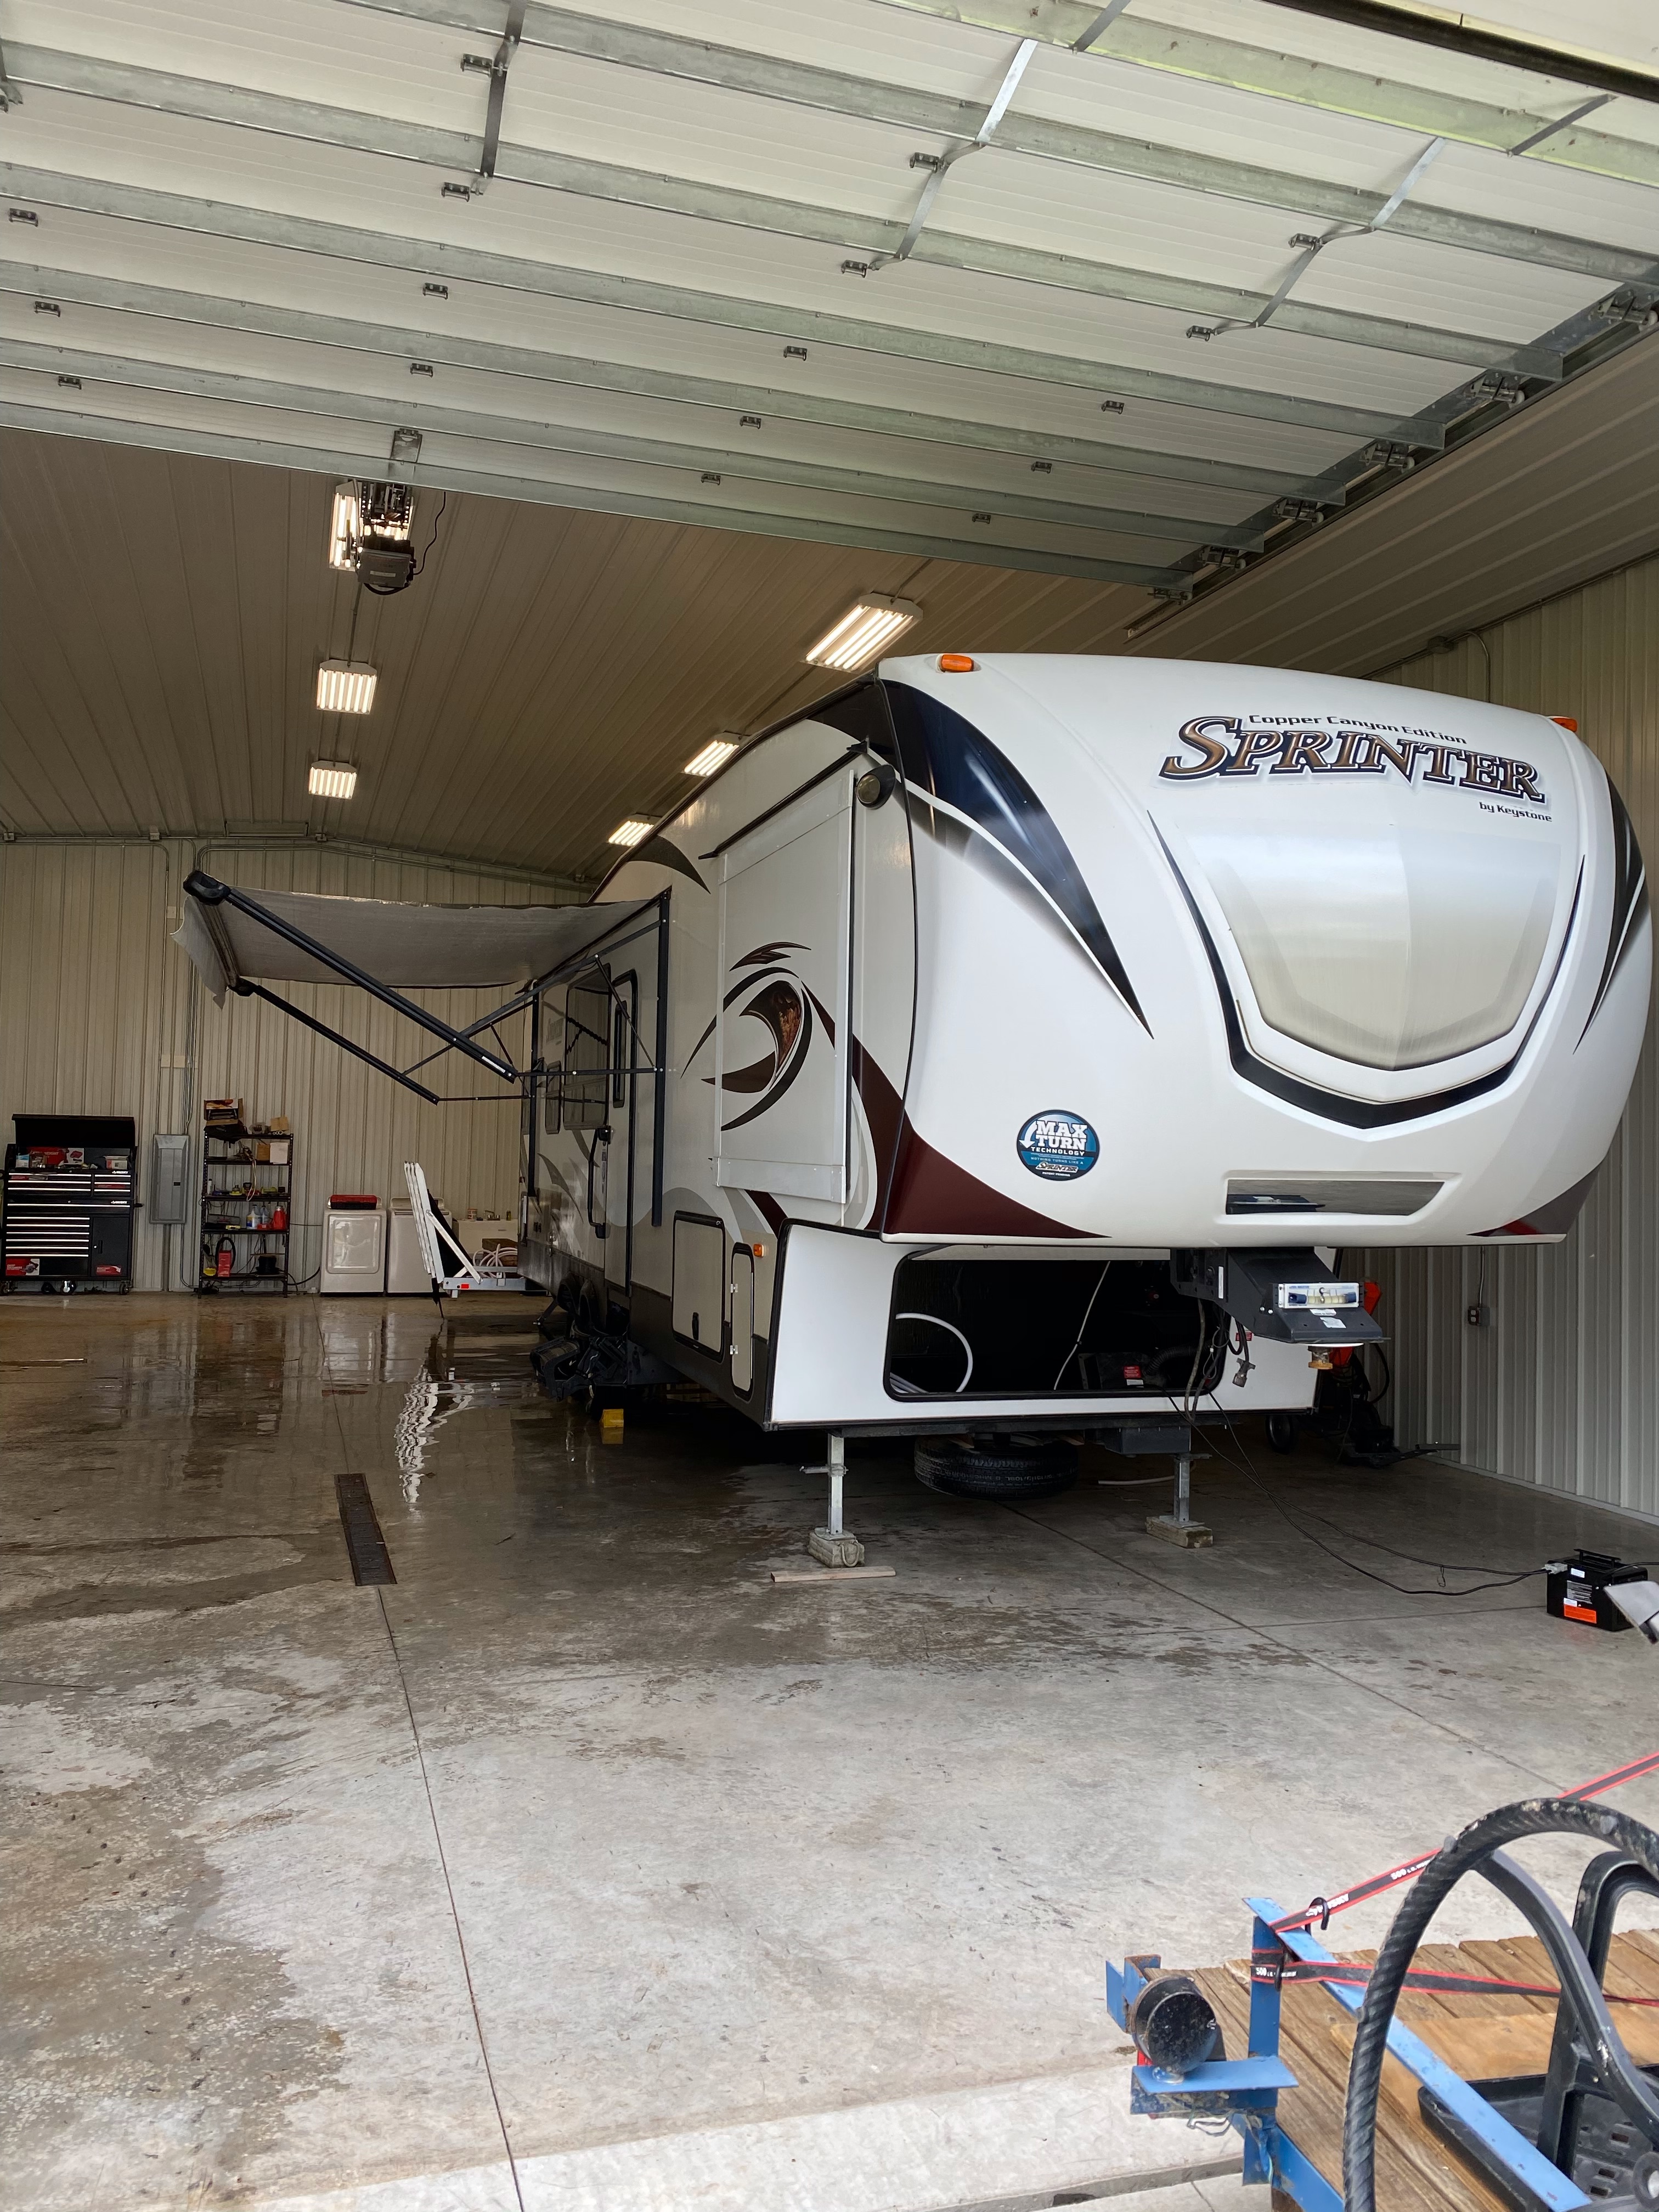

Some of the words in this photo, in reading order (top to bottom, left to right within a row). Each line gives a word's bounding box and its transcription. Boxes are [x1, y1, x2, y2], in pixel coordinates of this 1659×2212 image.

[1249, 715, 1322, 725] Copper
[1327, 716, 1399, 732] Canyon
[1401, 725, 1467, 744] Edition
[1159, 715, 1545, 803] SPRINTER
[1480, 802, 1494, 812] by
[1497, 804, 1553, 822] Keystone
[1036, 1120, 1087, 1138] MAX
[1035, 1135, 1087, 1150] TURN
[1031, 1147, 1085, 1156] TECHNOLOGY
[1390, 1869, 1407, 1880] 500
[1256, 1967, 1267, 1976] 500
